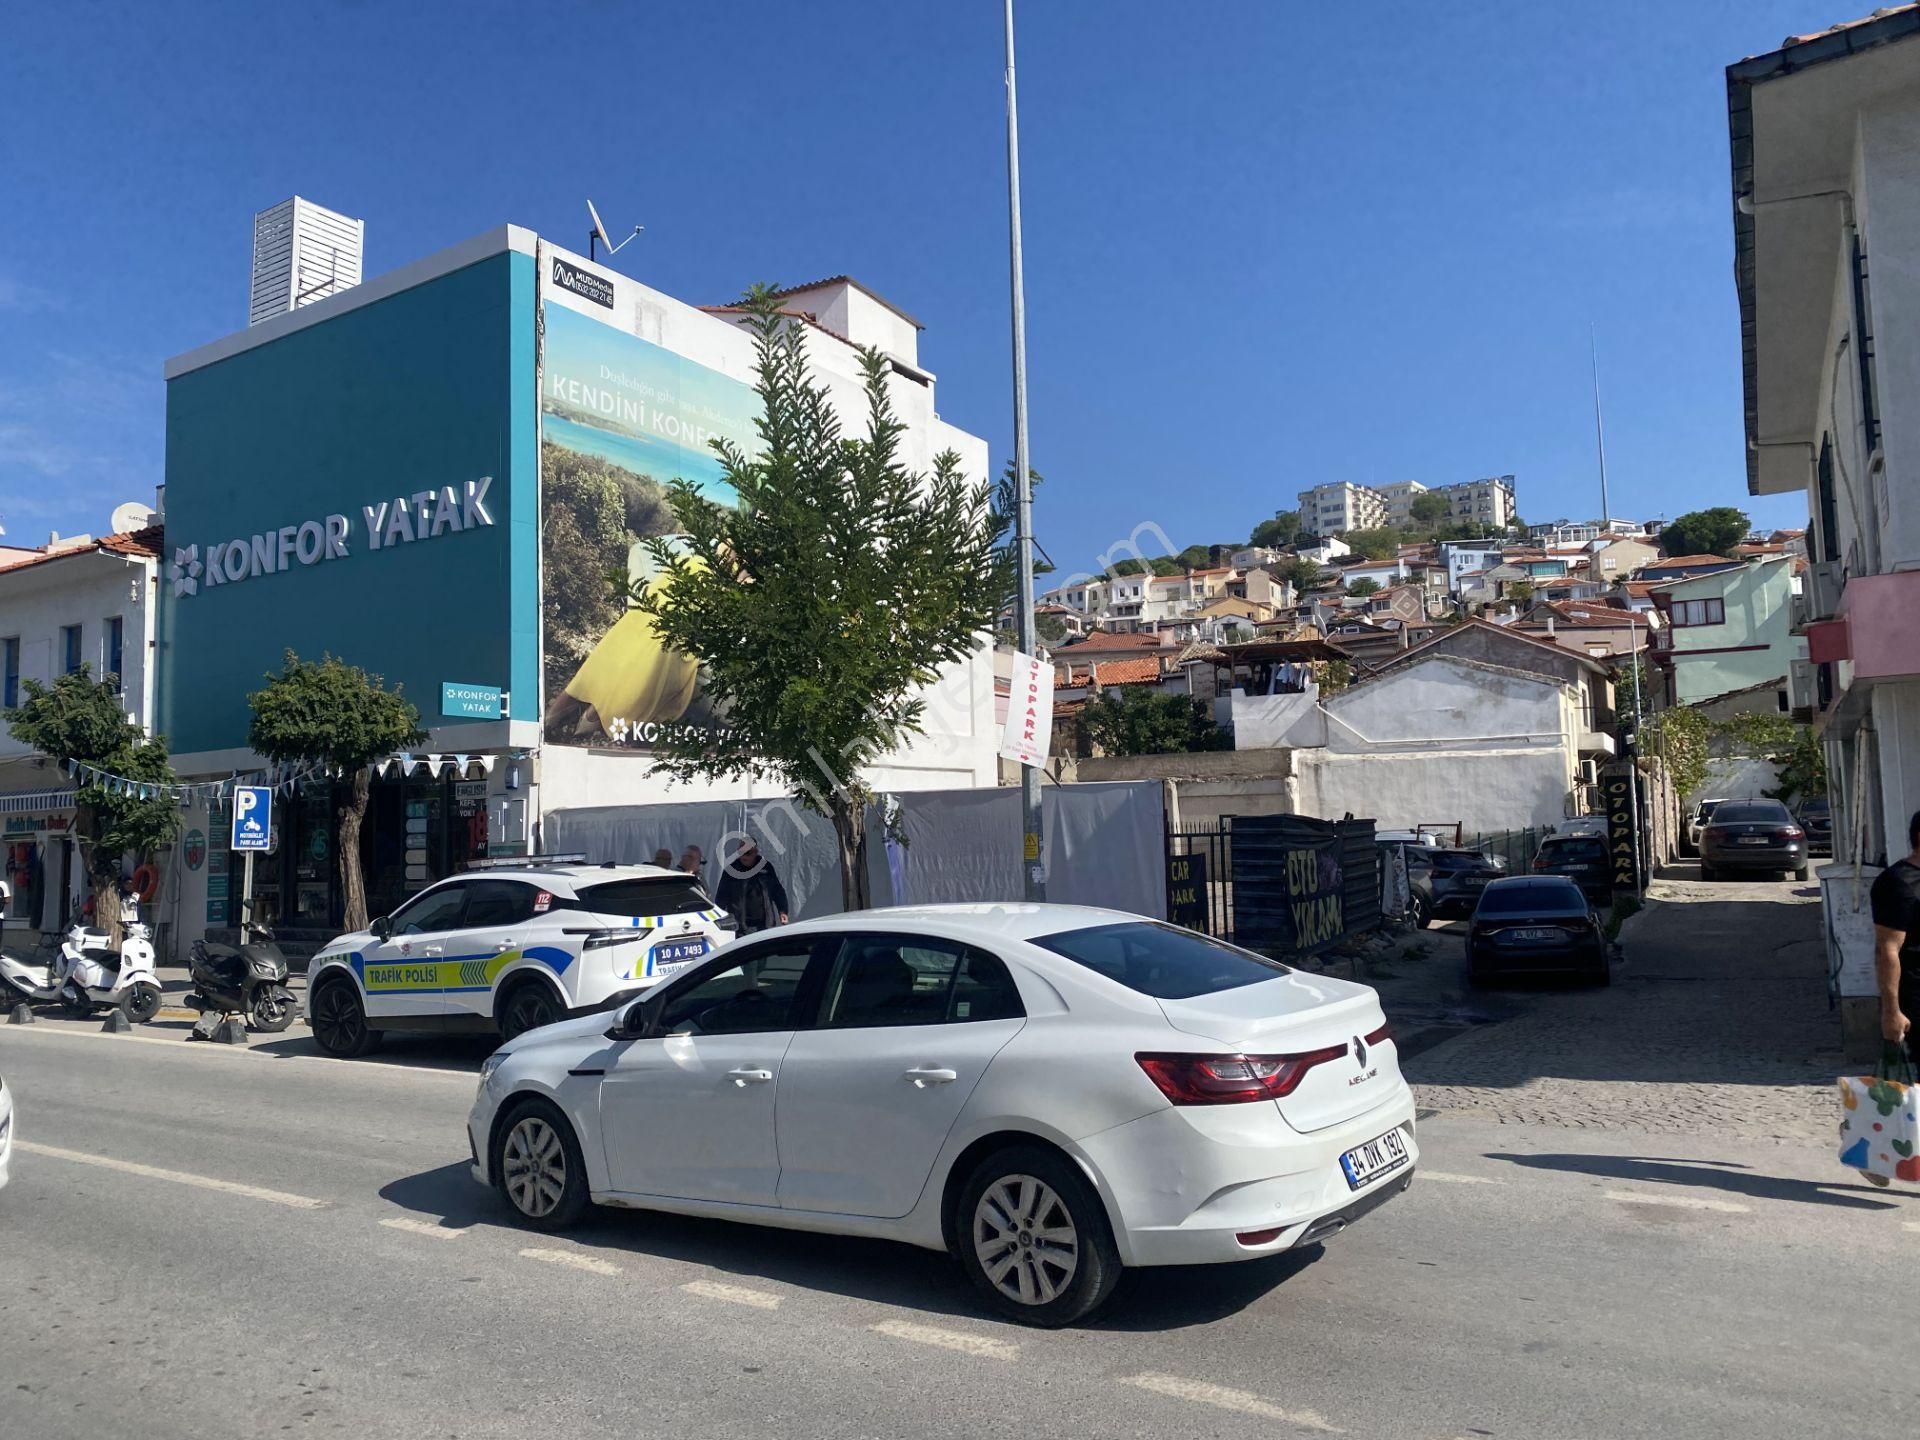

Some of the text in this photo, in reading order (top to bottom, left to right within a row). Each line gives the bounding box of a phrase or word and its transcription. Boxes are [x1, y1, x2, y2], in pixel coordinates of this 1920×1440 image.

[553, 374, 645, 427] KENDİNİ
[206, 476, 495, 587] KONFOR YATAK
[457, 690, 497, 702] KONFOR
[462, 702, 491, 713] YATAK
[1023, 660, 1039, 741] OTOPARK
[237, 790, 257, 820] P
[1609, 782, 1633, 883] OTOPARK
[477, 842, 486, 850] AY
[1171, 861, 1190, 881] CAR
[1287, 849, 1318, 896] OTO
[538, 893, 551, 904] 112
[661, 944, 703, 959] 10 A 7493
[369, 966, 438, 983] TRAFİK POLİSİ
[1349, 1151, 1366, 1176] 34
[1383, 1132, 1403, 1158] 192
